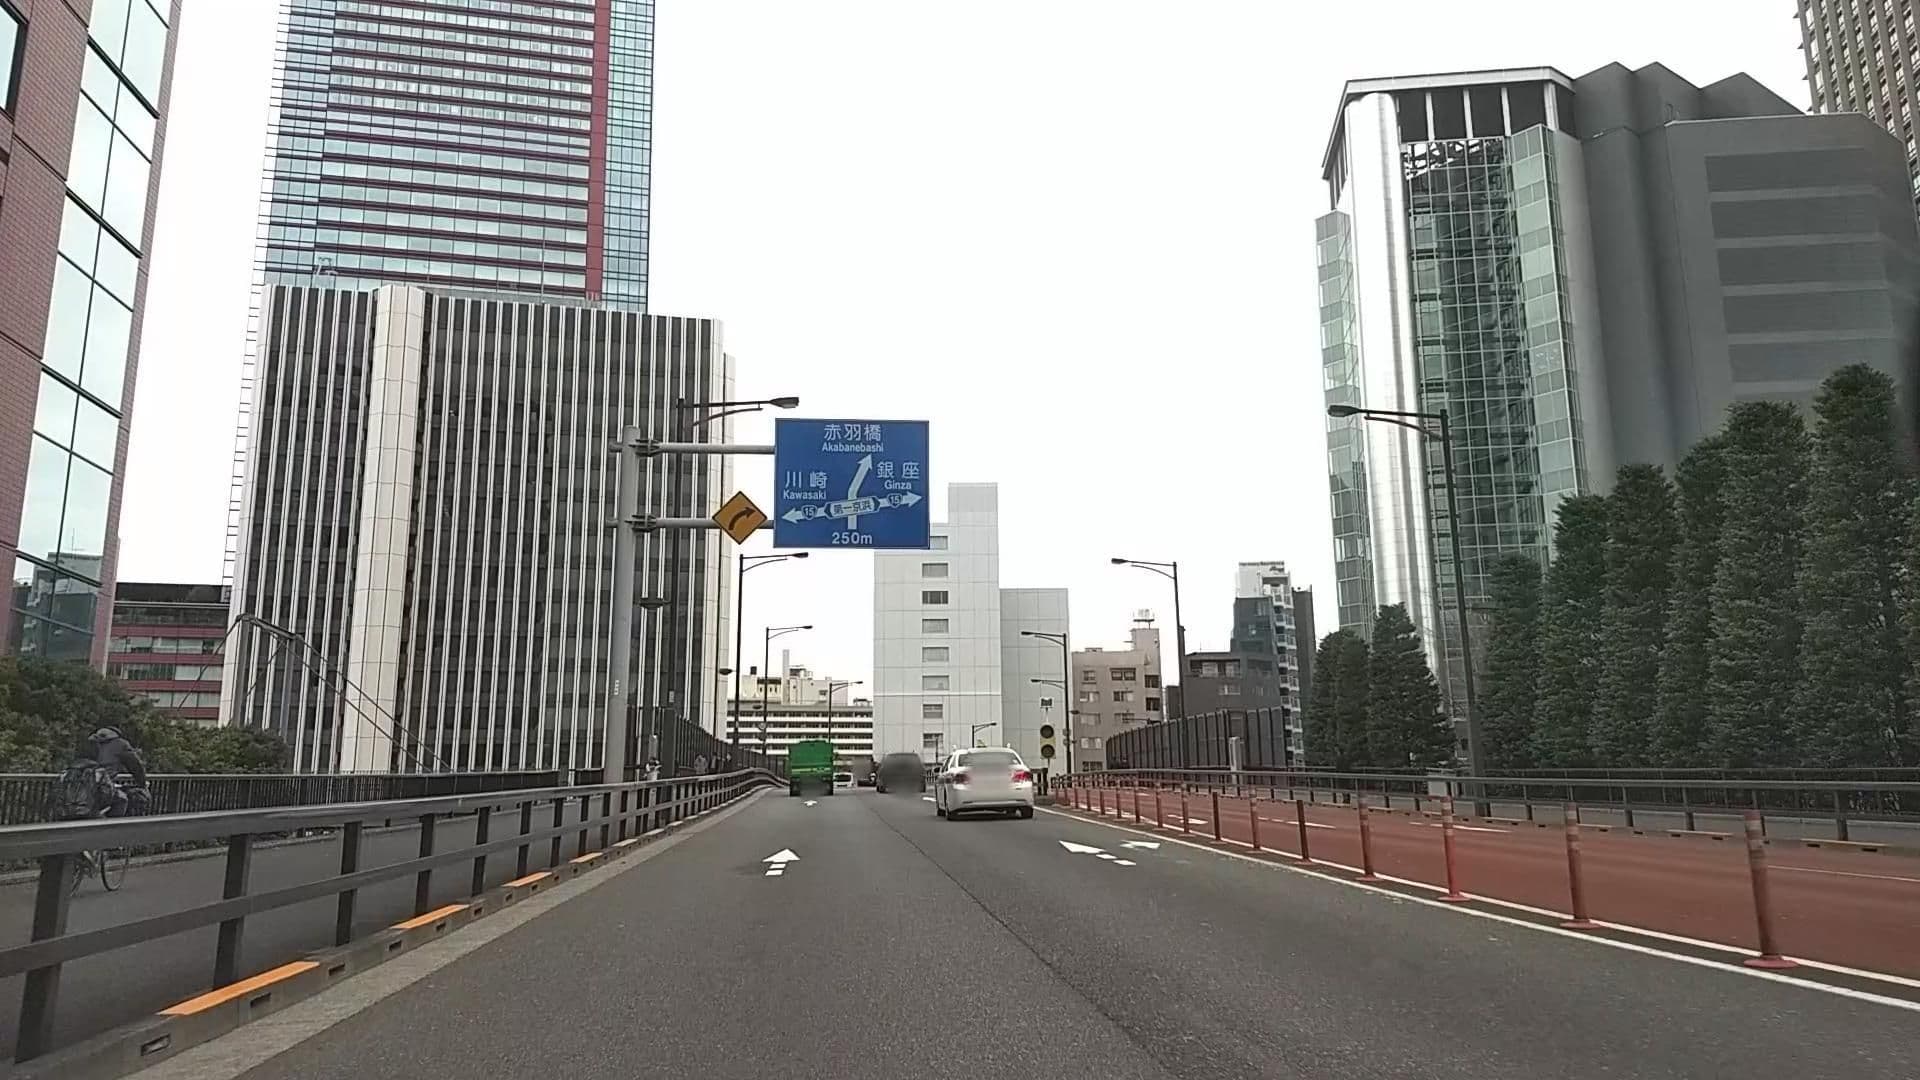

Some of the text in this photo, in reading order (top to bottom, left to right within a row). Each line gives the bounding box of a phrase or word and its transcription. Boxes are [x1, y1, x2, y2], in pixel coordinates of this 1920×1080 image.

[824, 423, 881, 442] 赤羽橋
[822, 443, 884, 452] Akabanebashi
[877, 461, 920, 479] 銀座
[785, 471, 828, 489] 川崎
[884, 480, 912, 490] Ginza
[783, 490, 827, 500] Kawasaki
[889, 495, 900, 504] 15
[804, 507, 815, 517] 15
[833, 500, 872, 515] 第一京浜
[831, 532, 873, 545] 250m
